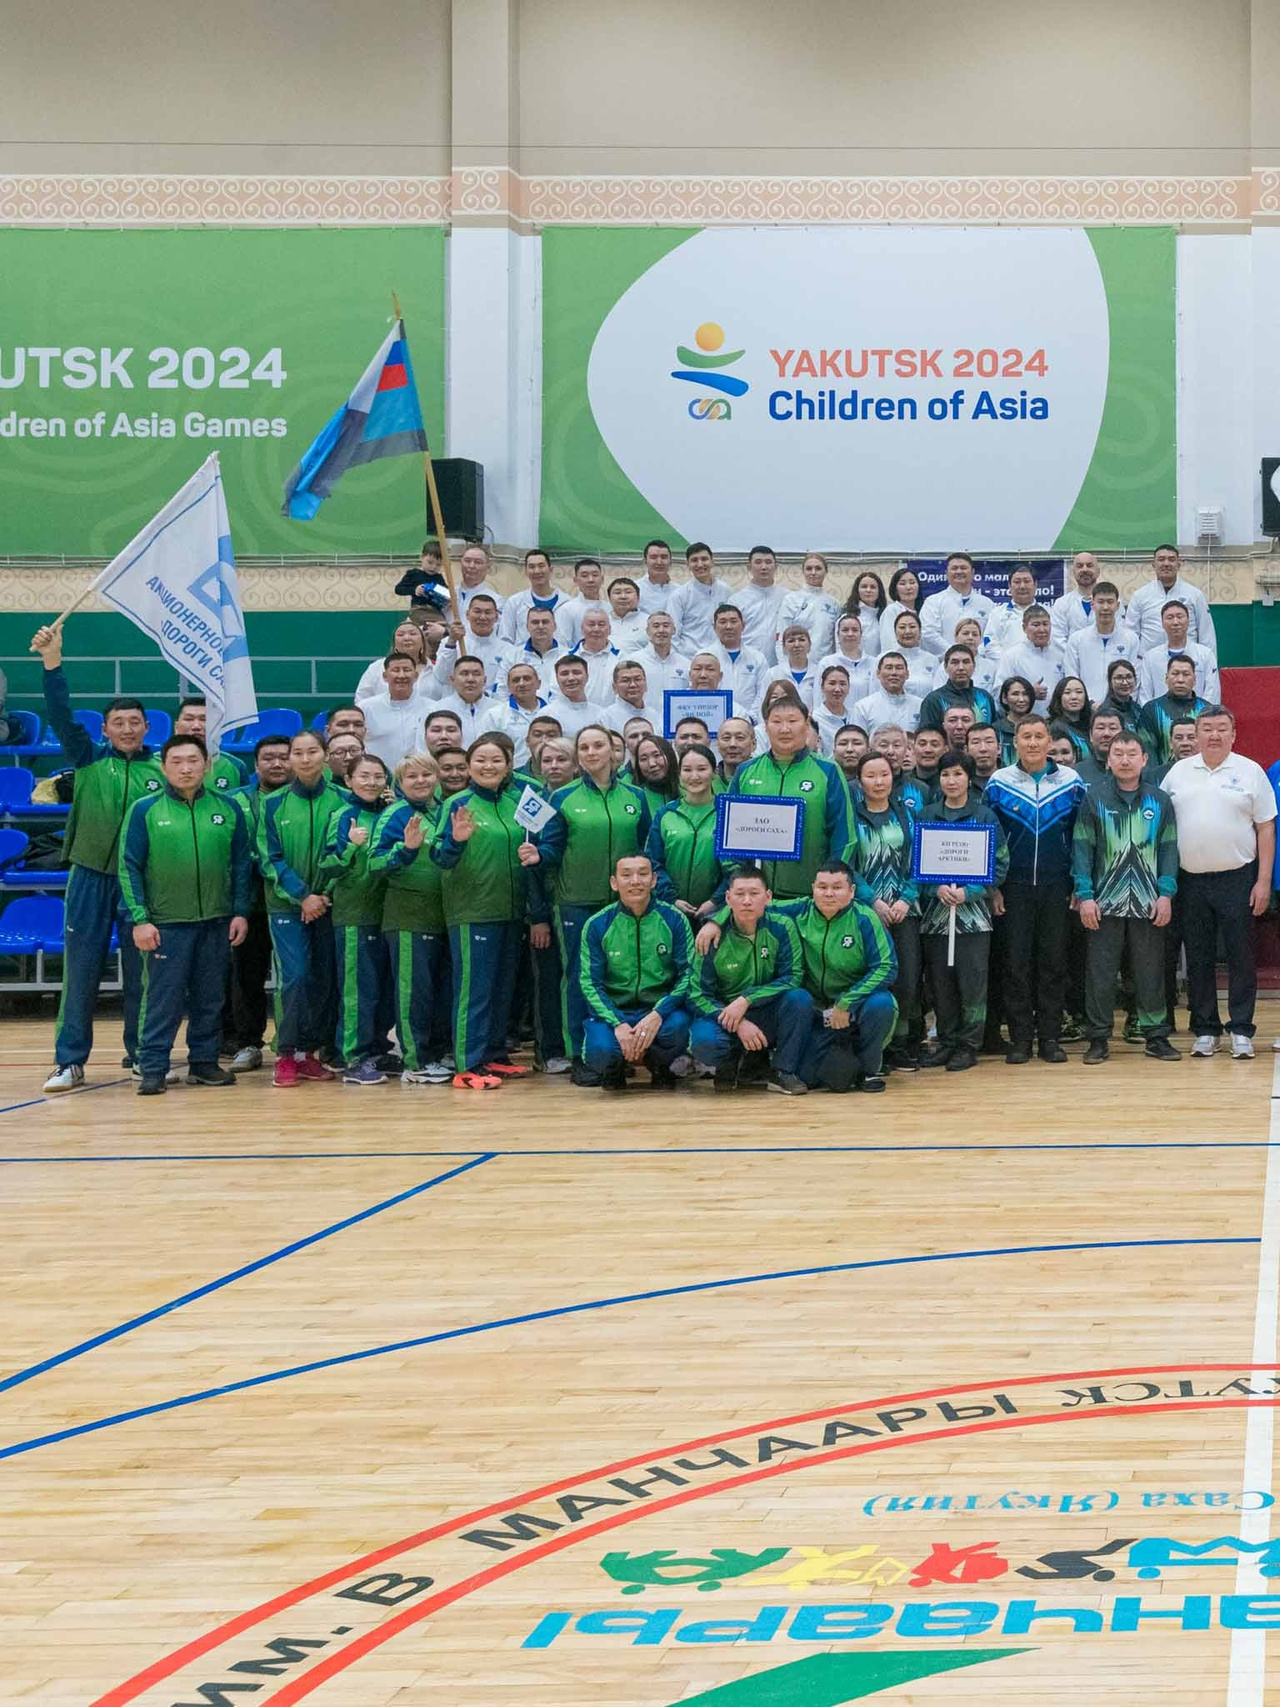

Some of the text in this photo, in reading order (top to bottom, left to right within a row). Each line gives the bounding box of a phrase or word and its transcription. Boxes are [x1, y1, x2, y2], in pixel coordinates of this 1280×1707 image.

[147, 346, 288, 389] 2024
[769, 349, 1049, 378] YAKUTSK 2024
[769, 389, 1049, 421] Children of Asia
[74, 411, 106, 438] of
[110, 411, 176, 438] Asia
[184, 411, 288, 438] Games
[985, 573, 1009, 582] мал
[161, 619, 209, 669] ДОРОГИ
[334, 1572, 434, 1606] В
[459, 1394, 1019, 1551] МАНЧААРЫ
[862, 1490, 1119, 1517] (Якутия)
[1142, 1489, 1276, 1511] Саха
